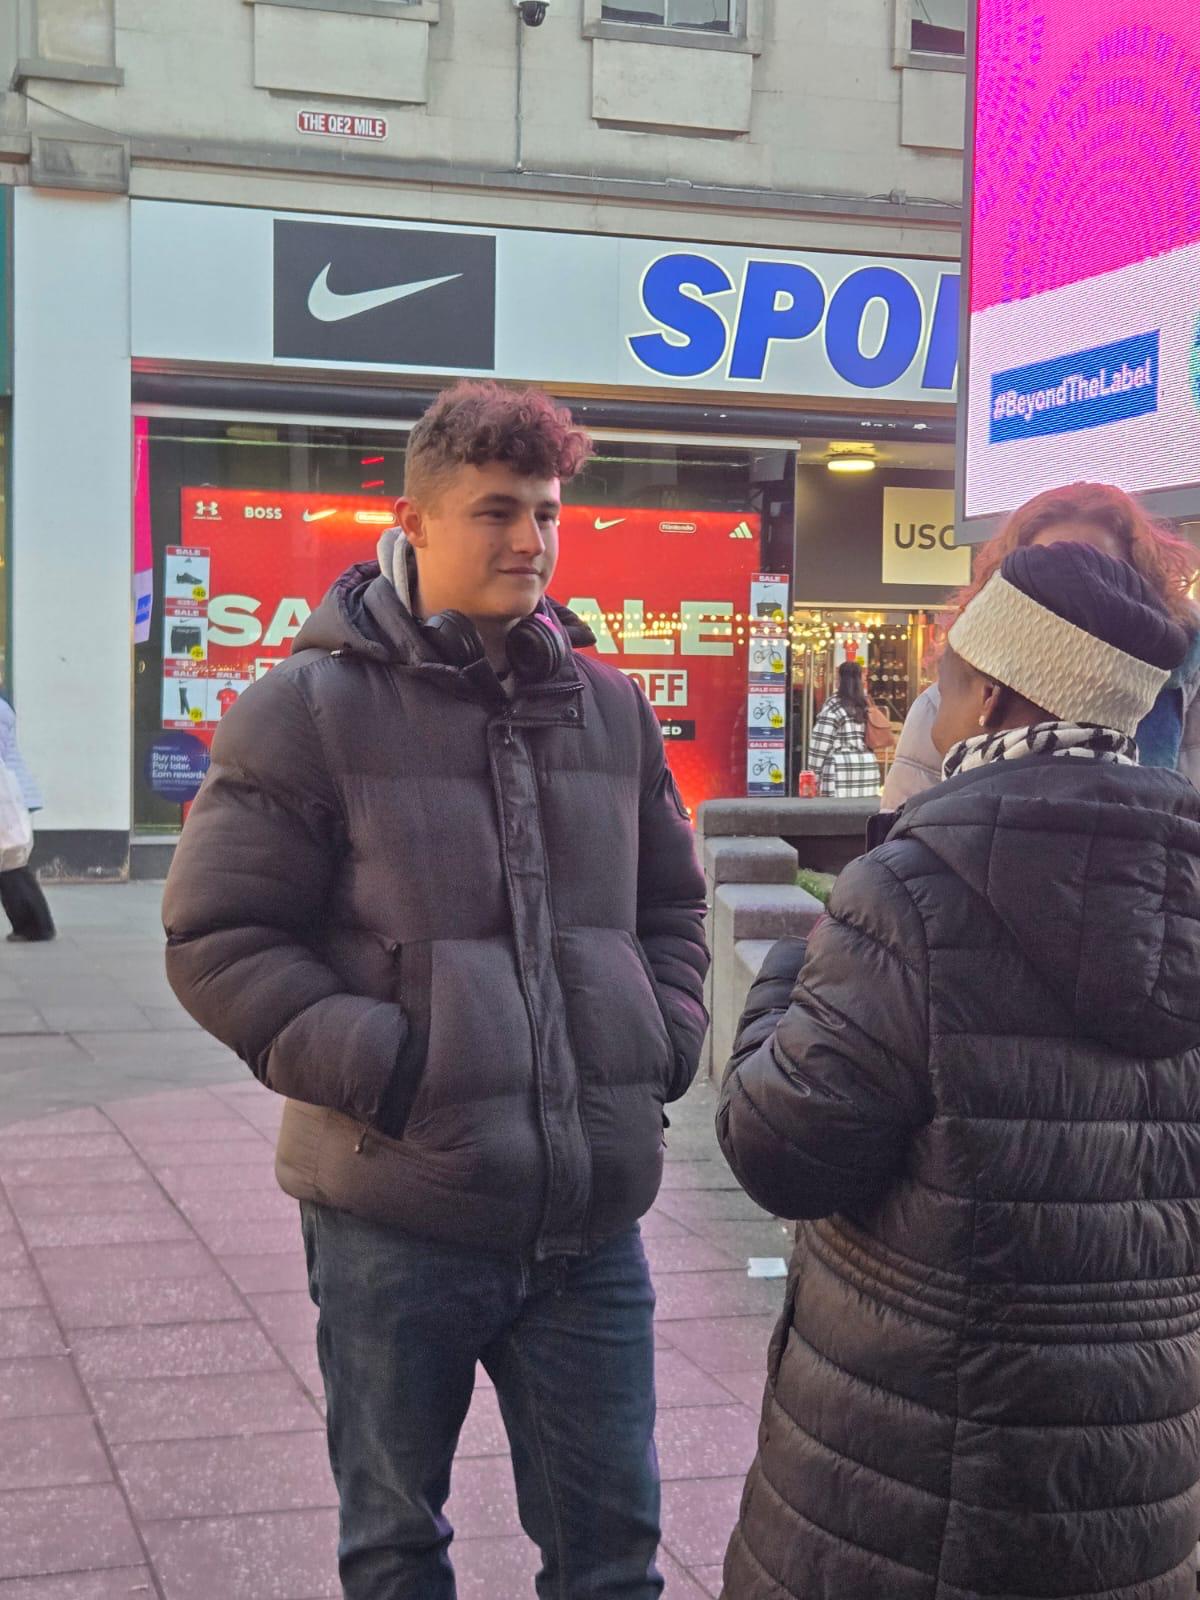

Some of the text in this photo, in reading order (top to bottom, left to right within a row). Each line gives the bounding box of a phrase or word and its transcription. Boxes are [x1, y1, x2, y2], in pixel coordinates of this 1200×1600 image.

[301, 113, 384, 137] THE QE2 MILE
[993, 356, 1152, 421] #BeyondTheLabel
[244, 506, 283, 520] BOSS
[174, 609, 200, 617] SALE
[152, 752, 169, 762] Buy
[152, 761, 169, 771] Pay
[152, 769, 172, 778] Earn
